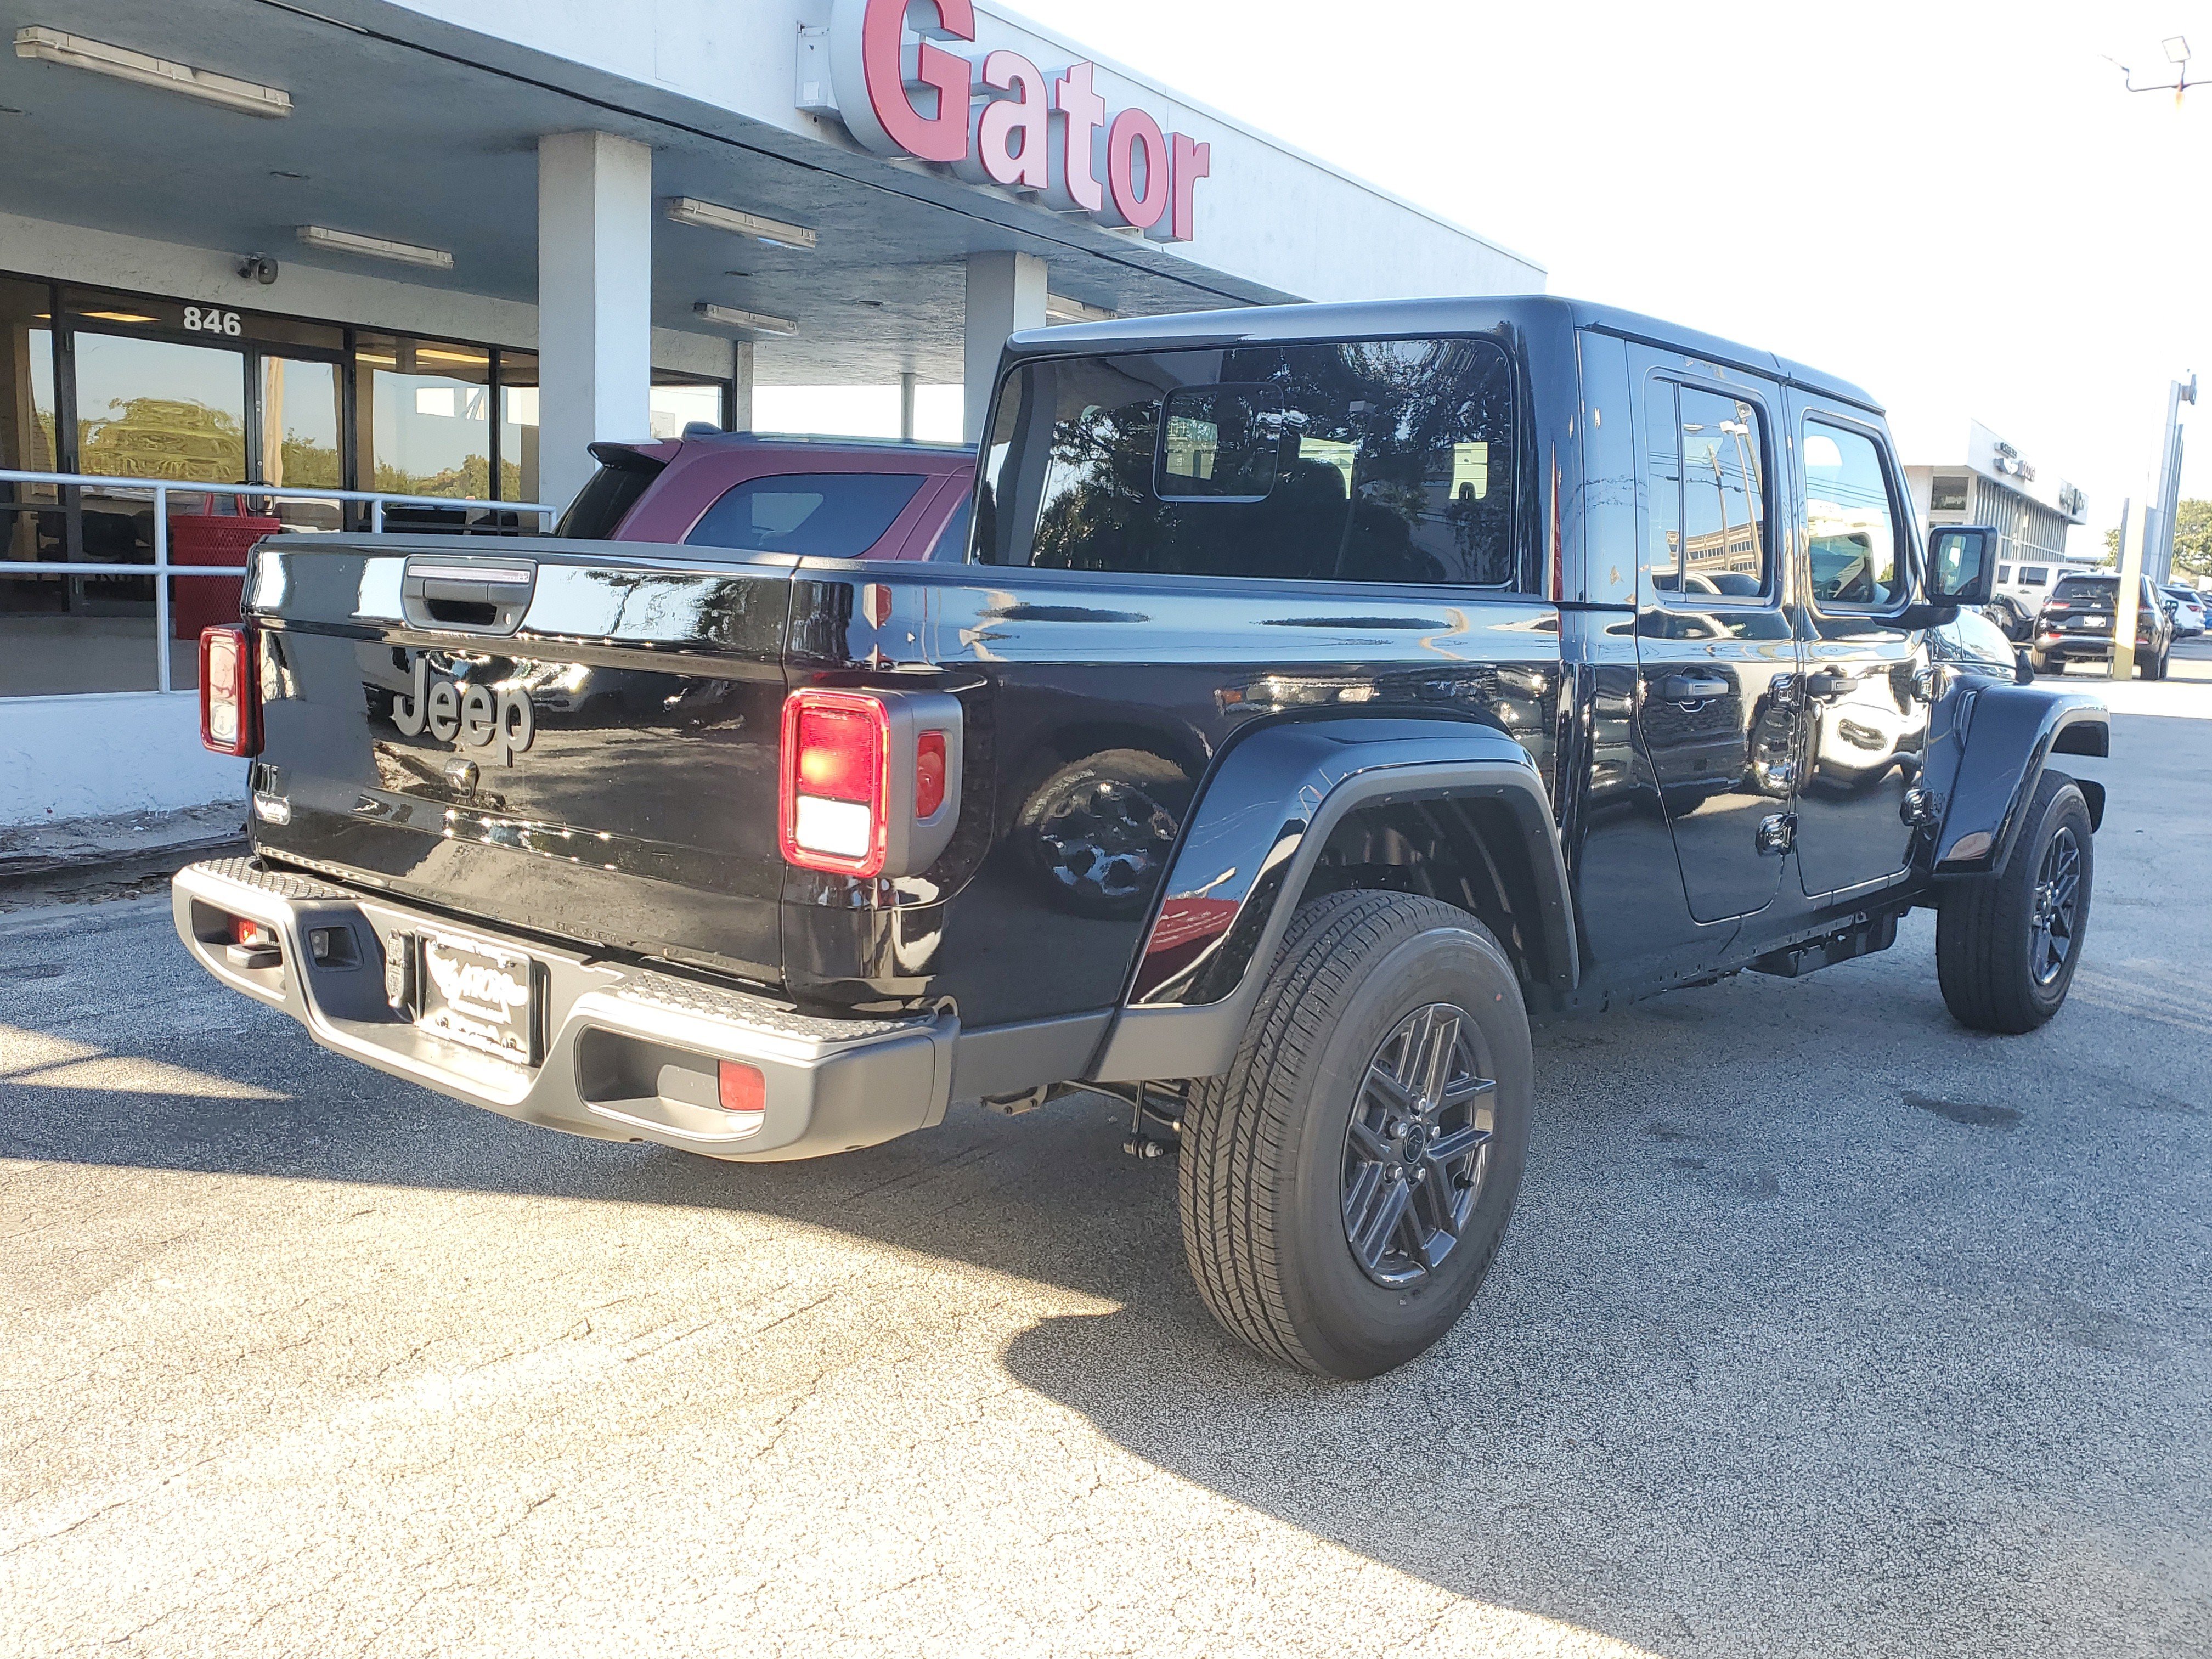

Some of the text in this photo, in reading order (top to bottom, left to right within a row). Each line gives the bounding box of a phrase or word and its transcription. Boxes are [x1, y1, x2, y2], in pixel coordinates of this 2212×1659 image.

[862, 0, 1210, 242] Gator
[183, 306, 241, 336] 846
[393, 657, 535, 768] Jeep
